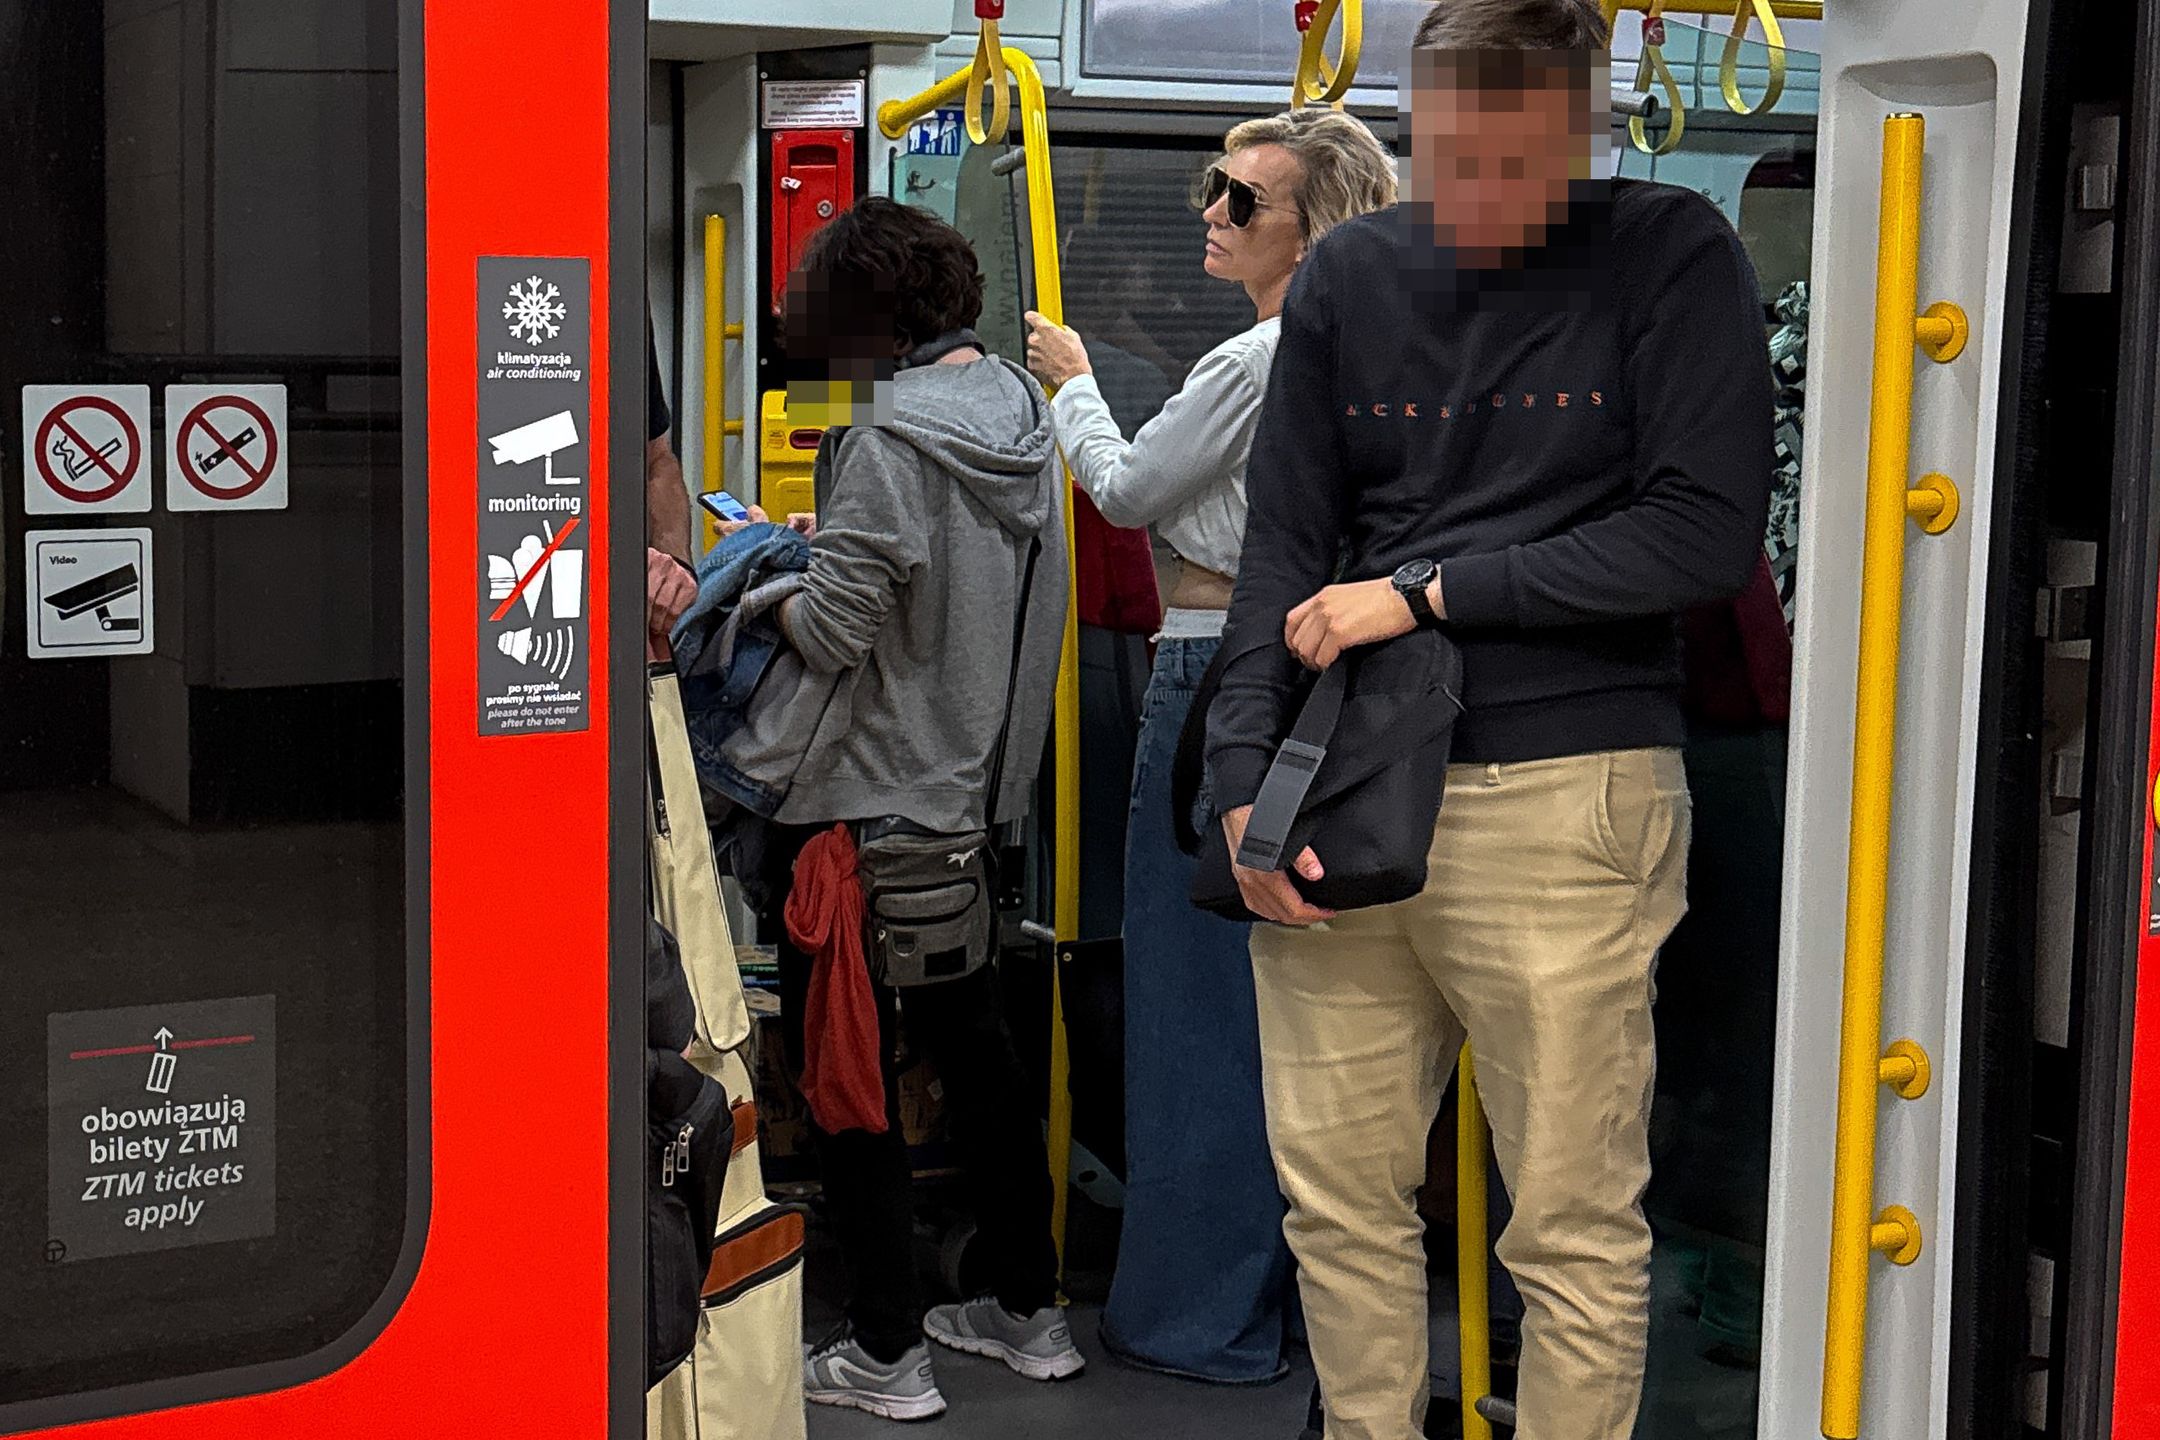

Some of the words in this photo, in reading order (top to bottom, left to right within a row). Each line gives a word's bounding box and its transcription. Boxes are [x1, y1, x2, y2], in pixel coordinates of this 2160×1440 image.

[497, 352, 572, 367] klimatyzacja
[486, 367, 504, 380] air
[506, 367, 581, 382] conditioning
[488, 493, 582, 515] monitoring
[49, 556, 77, 564] Video
[508, 684, 521, 695] po
[523, 681, 559, 694] sygnale
[486, 694, 524, 706] prosimy
[526, 693, 541, 702] nie
[543, 691, 581, 702] wsiadać
[487, 708, 518, 720] please
[520, 706, 533, 716] do
[534, 706, 552, 716] not
[553, 705, 580, 715] enter
[501, 718, 525, 728] after
[526, 717, 542, 726] the
[545, 717, 566, 726] tone
[81, 1094, 245, 1133] obowiązują
[89, 1136, 170, 1164] bilety
[178, 1125, 239, 1154] ZTM
[81, 1170, 147, 1202] ZTM
[154, 1162, 245, 1193] tickets
[124, 1195, 205, 1231] apply
